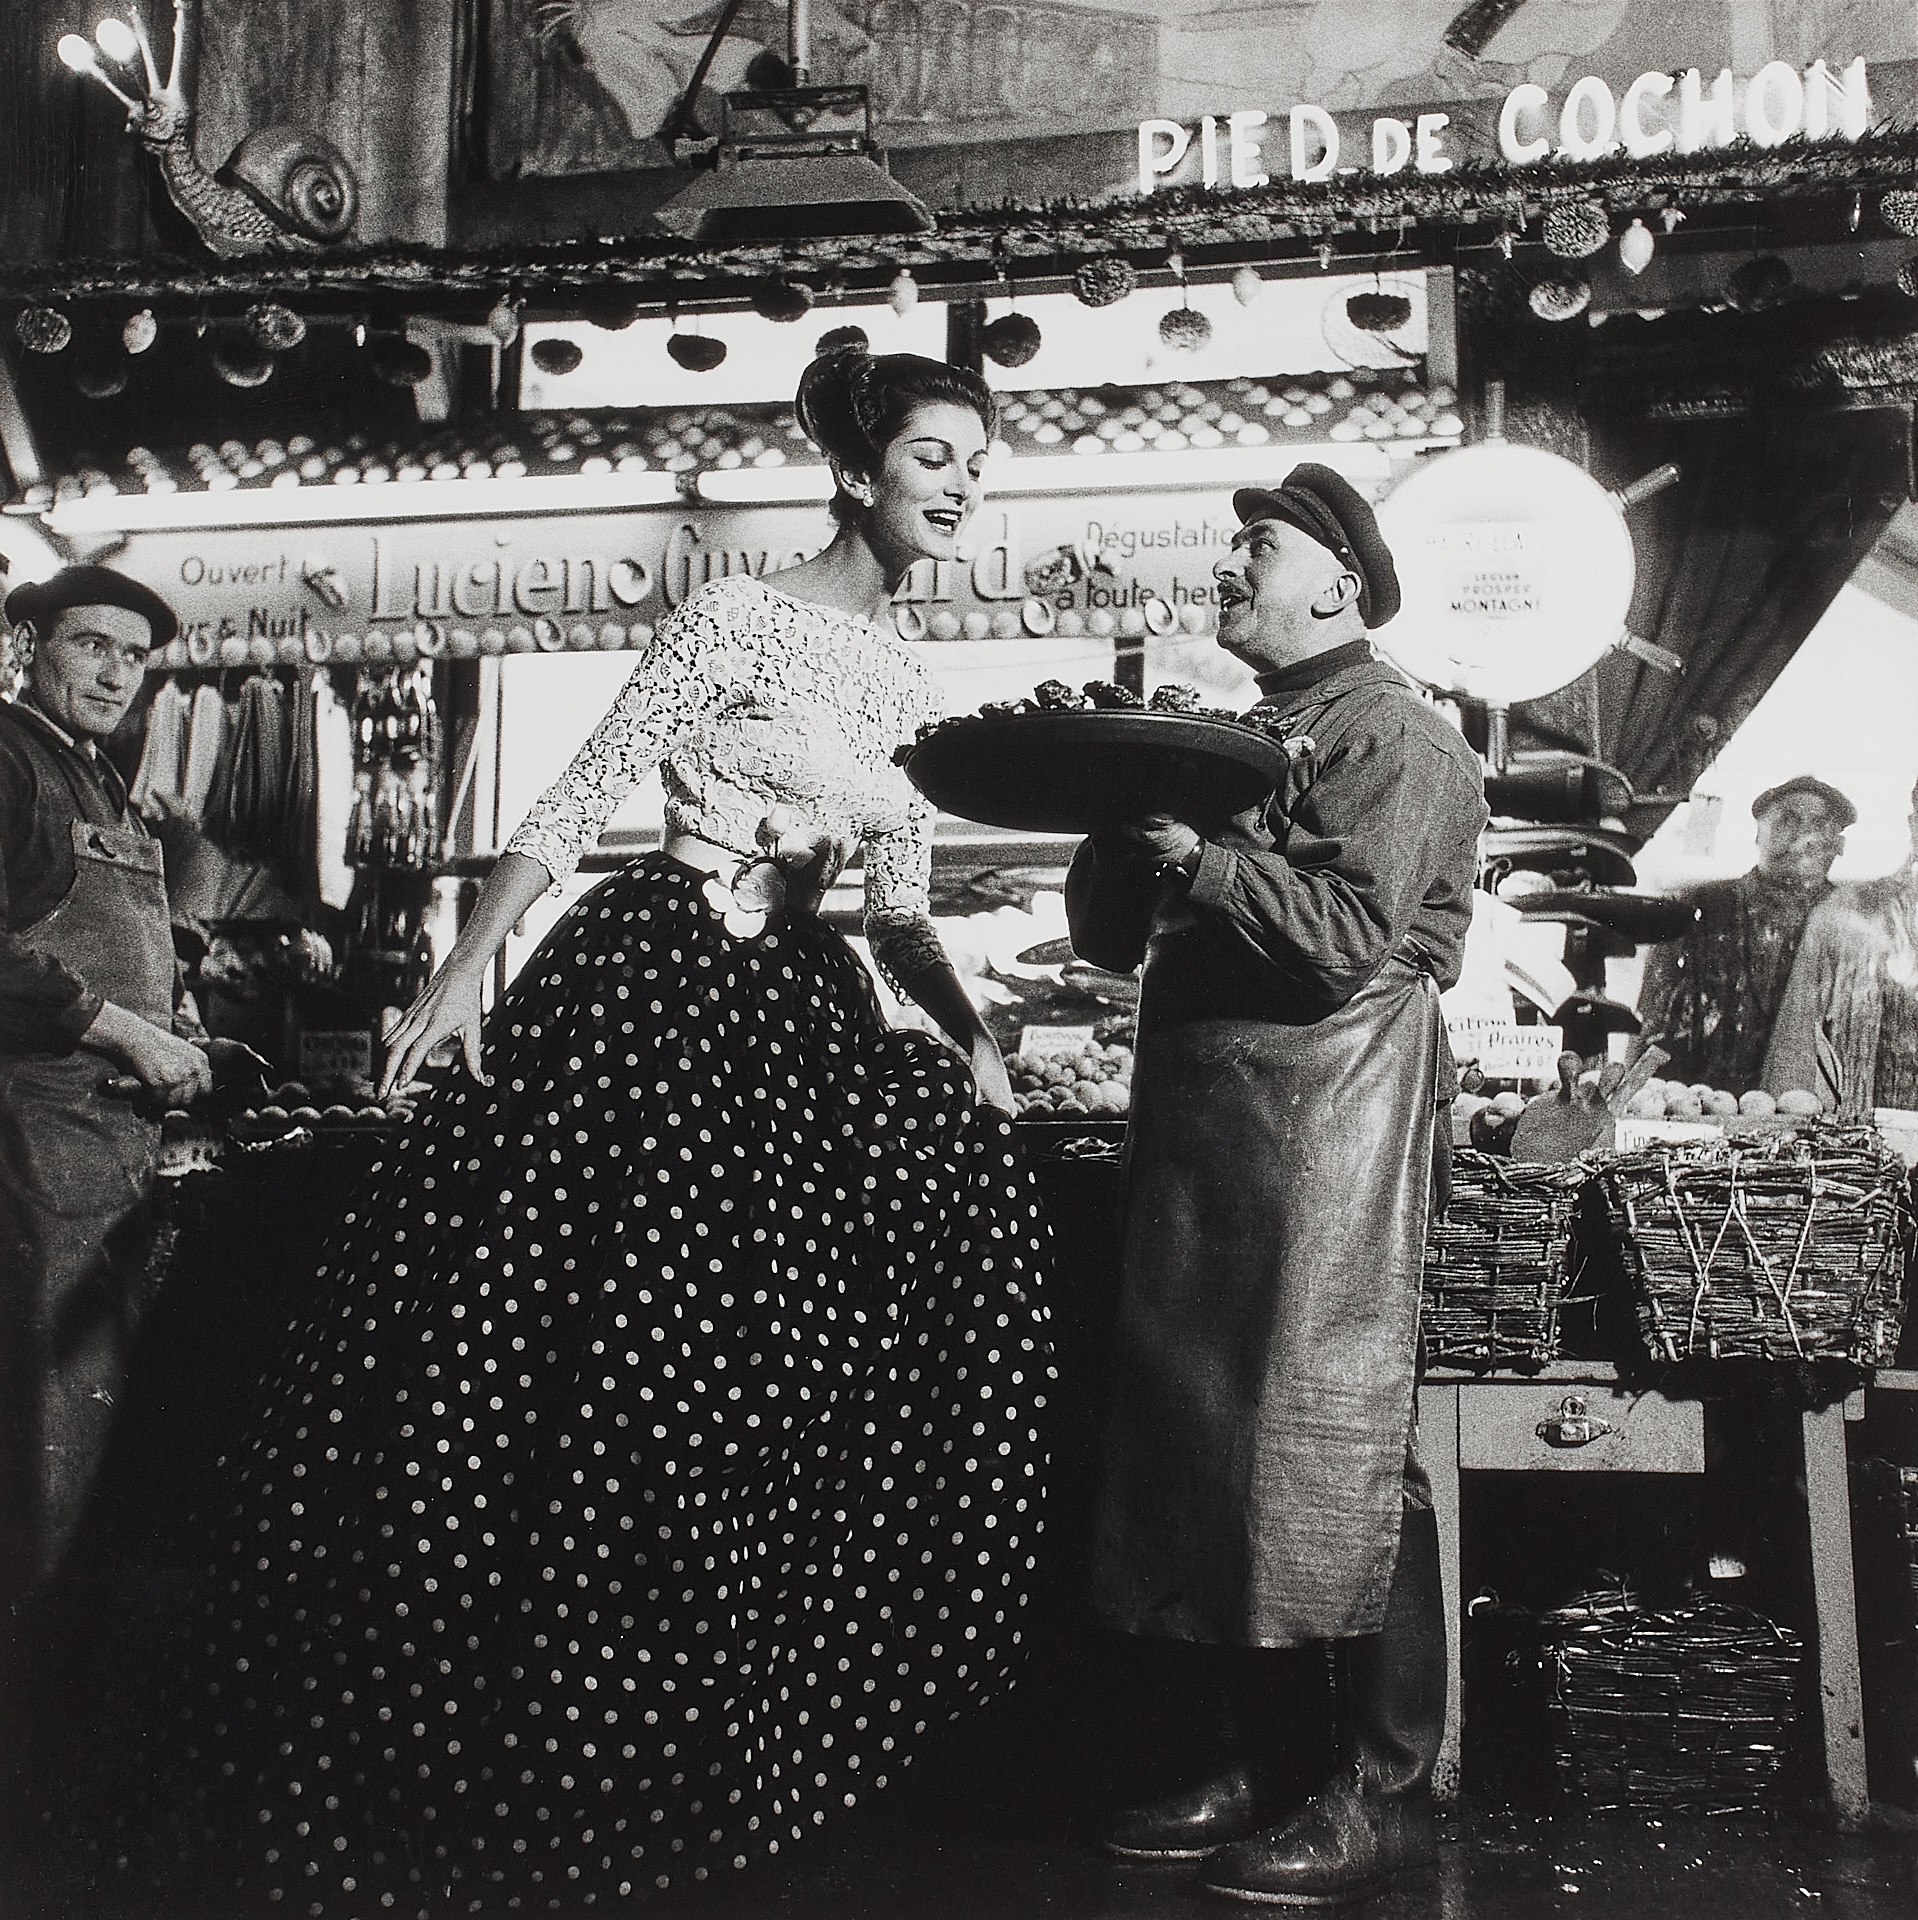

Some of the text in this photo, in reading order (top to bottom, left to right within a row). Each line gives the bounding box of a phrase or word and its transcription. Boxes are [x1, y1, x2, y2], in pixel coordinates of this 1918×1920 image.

[1138, 55, 1868, 195] PIED DE COCHON
[181, 555, 290, 586] Ouvert
[367, 529, 609, 623] Lucien
[1086, 576, 1155, 608] toute
[249, 606, 311, 643] Nuit
